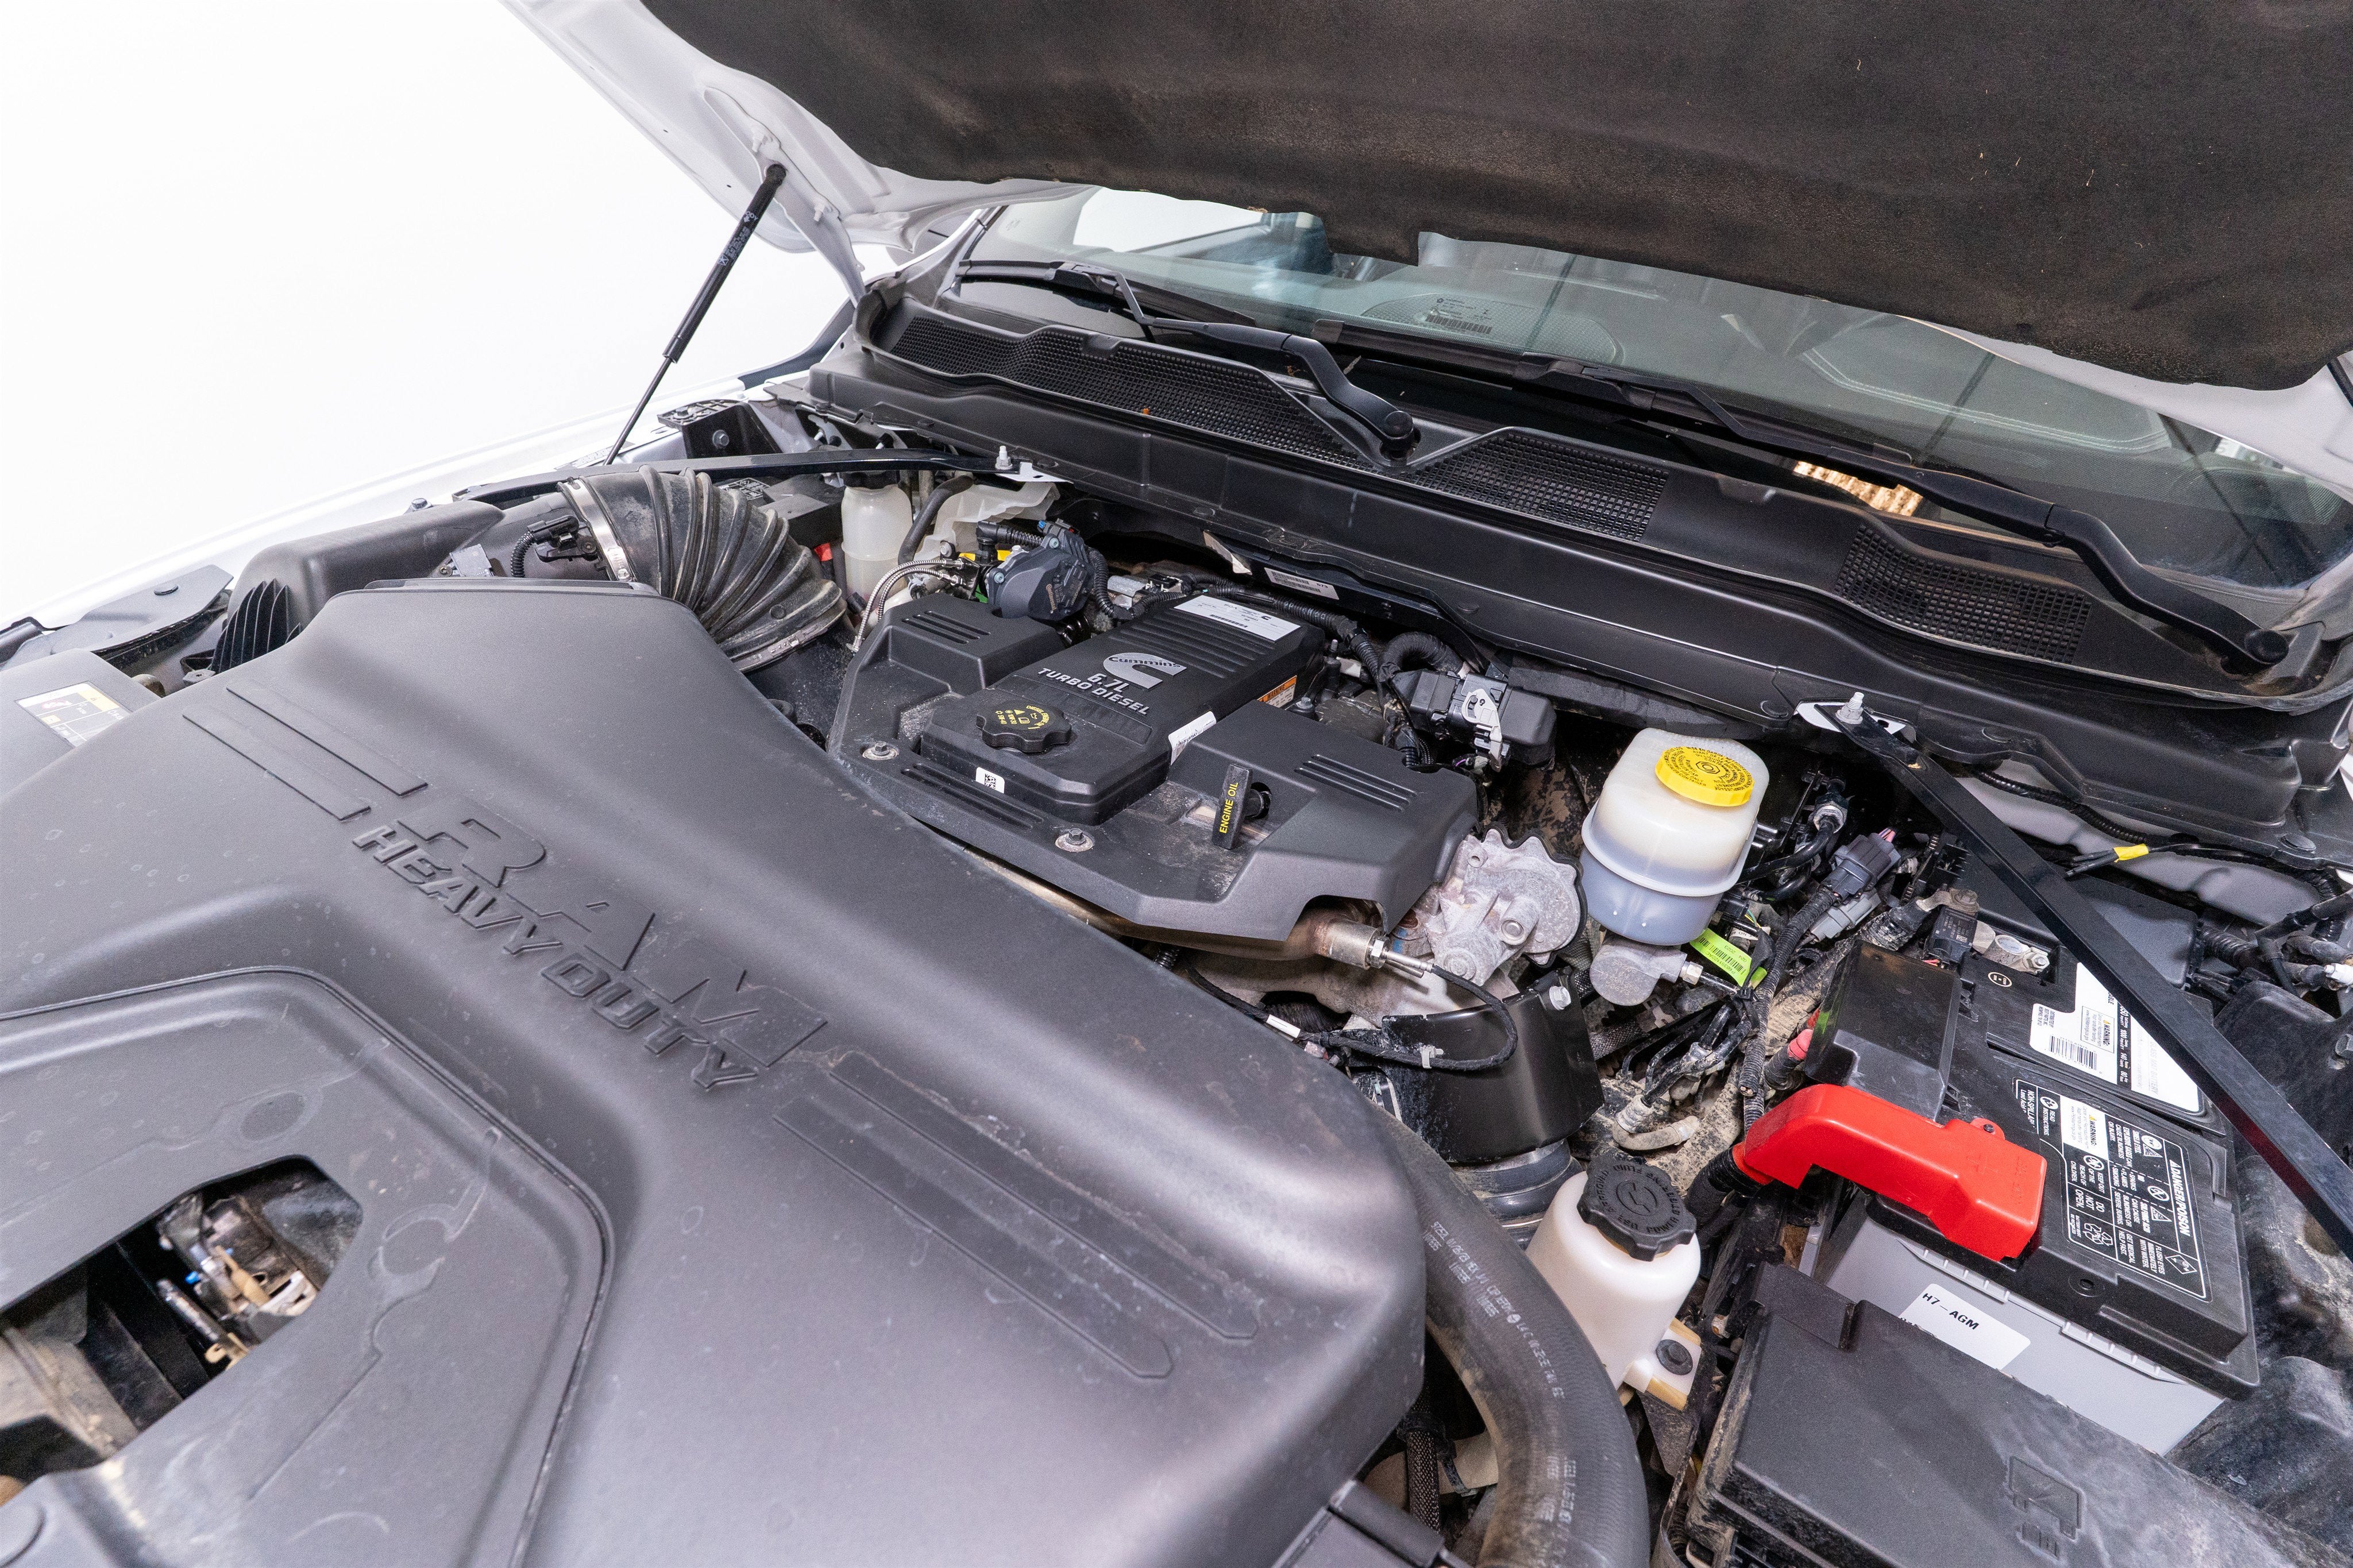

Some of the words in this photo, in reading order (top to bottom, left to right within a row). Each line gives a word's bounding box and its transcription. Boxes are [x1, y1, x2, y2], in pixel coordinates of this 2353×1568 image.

[1045, 584, 1056, 610] Continental
[1108, 656, 1182, 668] Cummins
[1087, 673, 1129, 693] 6.7L
[1037, 667, 1093, 690] TURBO
[1091, 687, 1150, 715] DIESEL
[1026, 705, 1044, 713] DIESEL
[1703, 754, 1723, 763] LIQUIDE
[1678, 773, 1706, 786] CONTAINER
[1219, 799, 1233, 834] ENGINE
[1228, 782, 1239, 797] OIL
[396, 802, 827, 1067] RAM
[1723, 944, 1736, 954] 2023
[352, 825, 563, 955] HEAVY
[541, 952, 759, 1091] DUTY
[1738, 955, 1748, 963] 024
[2019, 1088, 2027, 1100] Lead
[2019, 1098, 2028, 1111] Acid
[2041, 1106, 2050, 1137] INSTRUCTIONS.
[2047, 1109, 2057, 1123] READ
[2088, 1119, 2098, 1148] WARNING:
[2078, 1164, 2086, 1180] REACH
[2096, 1171, 2104, 1184] KEEP
[2110, 1165, 2120, 1187] SMOKING
[2119, 1169, 2128, 1188] FLAMES
[2080, 1177, 2087, 1186] OF
[2097, 1182, 2105, 1194] OUT
[2075, 1188, 2084, 1210] OPEN.
[2084, 1194, 2095, 1211] NOT
[2094, 1200, 2105, 1213] DO
[2112, 1190, 2123, 1210] SEVERE
[2130, 1197, 2138, 1210] CAN
[2170, 1167, 2190, 1237] DANGER/POISON
[2121, 1194, 2132, 1220] BLINDNESS
[2124, 1218, 2132, 1228] OR
[2131, 1207, 2140, 1224] CAUSE
[2117, 1230, 2126, 1244] HELP
[2125, 1233, 2133, 1244] GET
[2119, 1242, 2128, 1257] FAST.
[2138, 1238, 2147, 1252] WITH
[2126, 1242, 2136, 1265] MEDICAL
[2146, 1241, 2158, 1273] IMMEDIATELY
[2154, 1244, 2163, 1262] FLUSH
[2157, 1260, 2165, 1275] EYES
